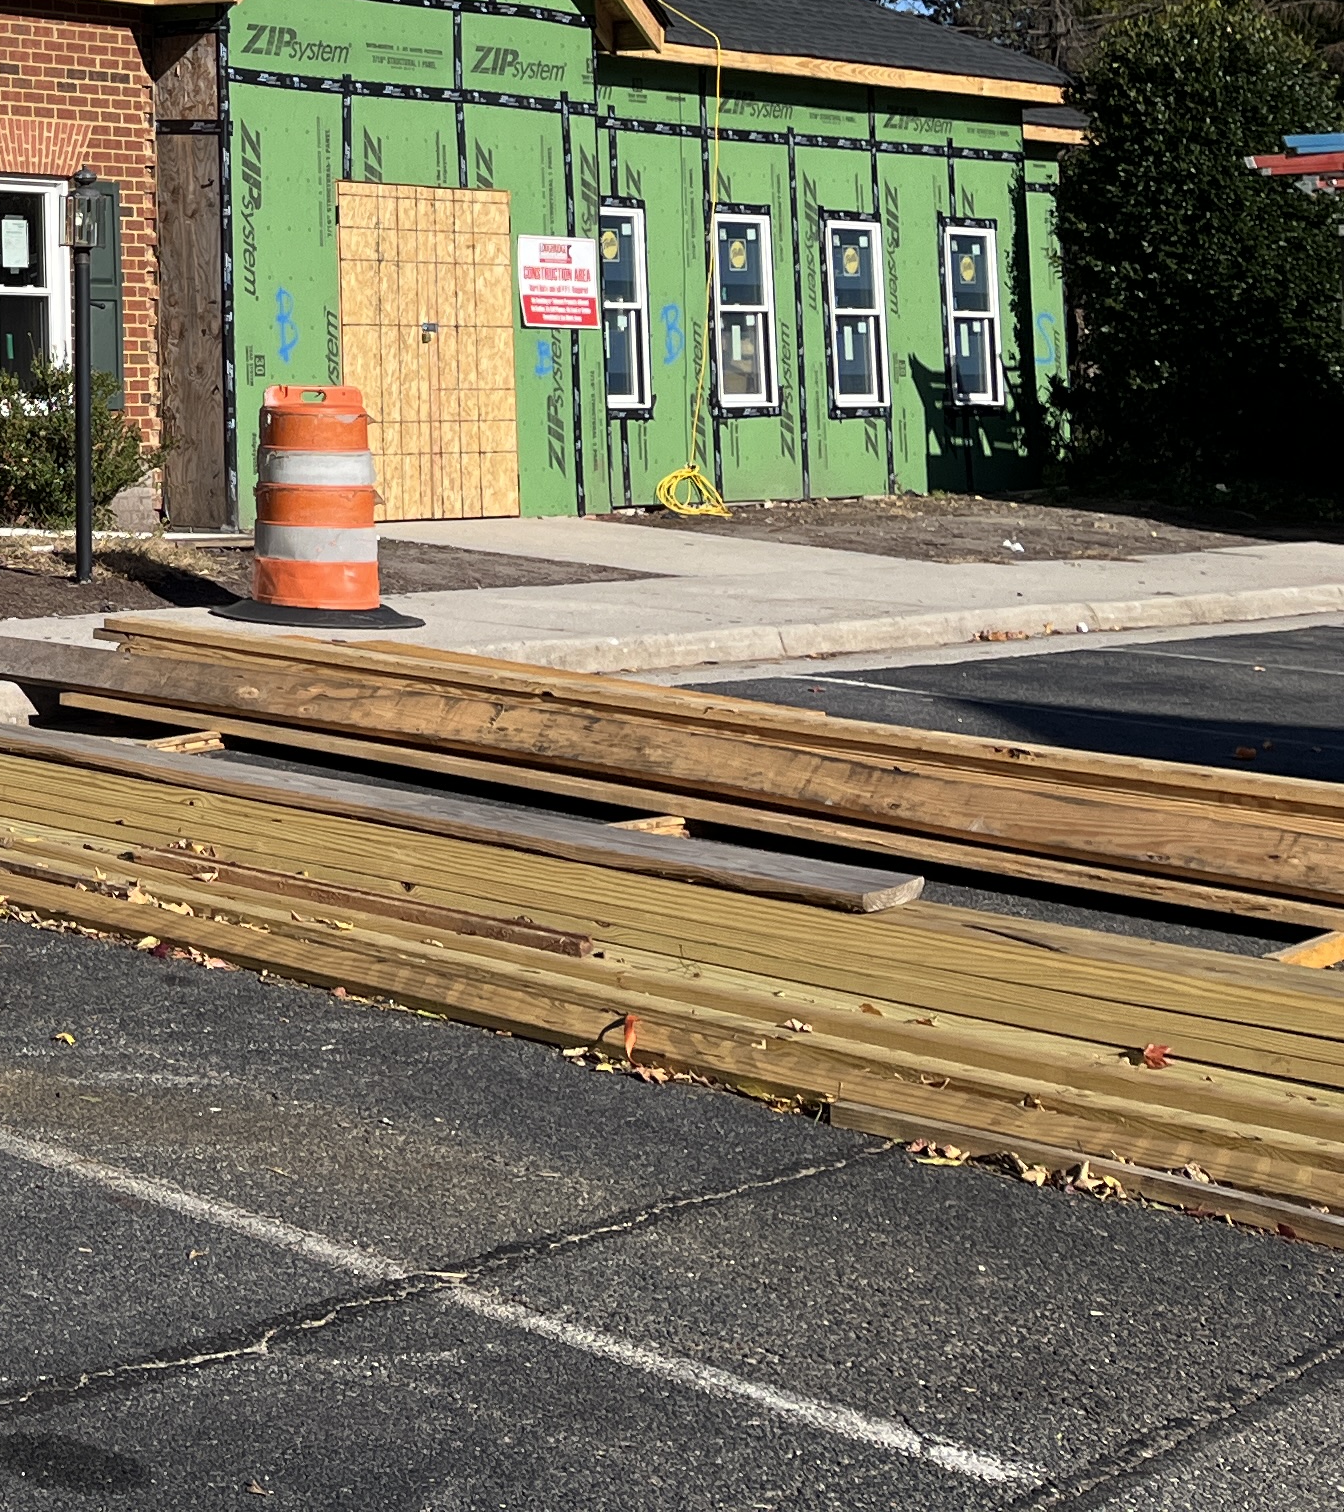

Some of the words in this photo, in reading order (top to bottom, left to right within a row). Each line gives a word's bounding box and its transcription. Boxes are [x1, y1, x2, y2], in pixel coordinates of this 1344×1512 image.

[523, 266, 573, 281] CONSTRUCTION
[574, 268, 592, 282] AREA
[661, 303, 685, 365] B
